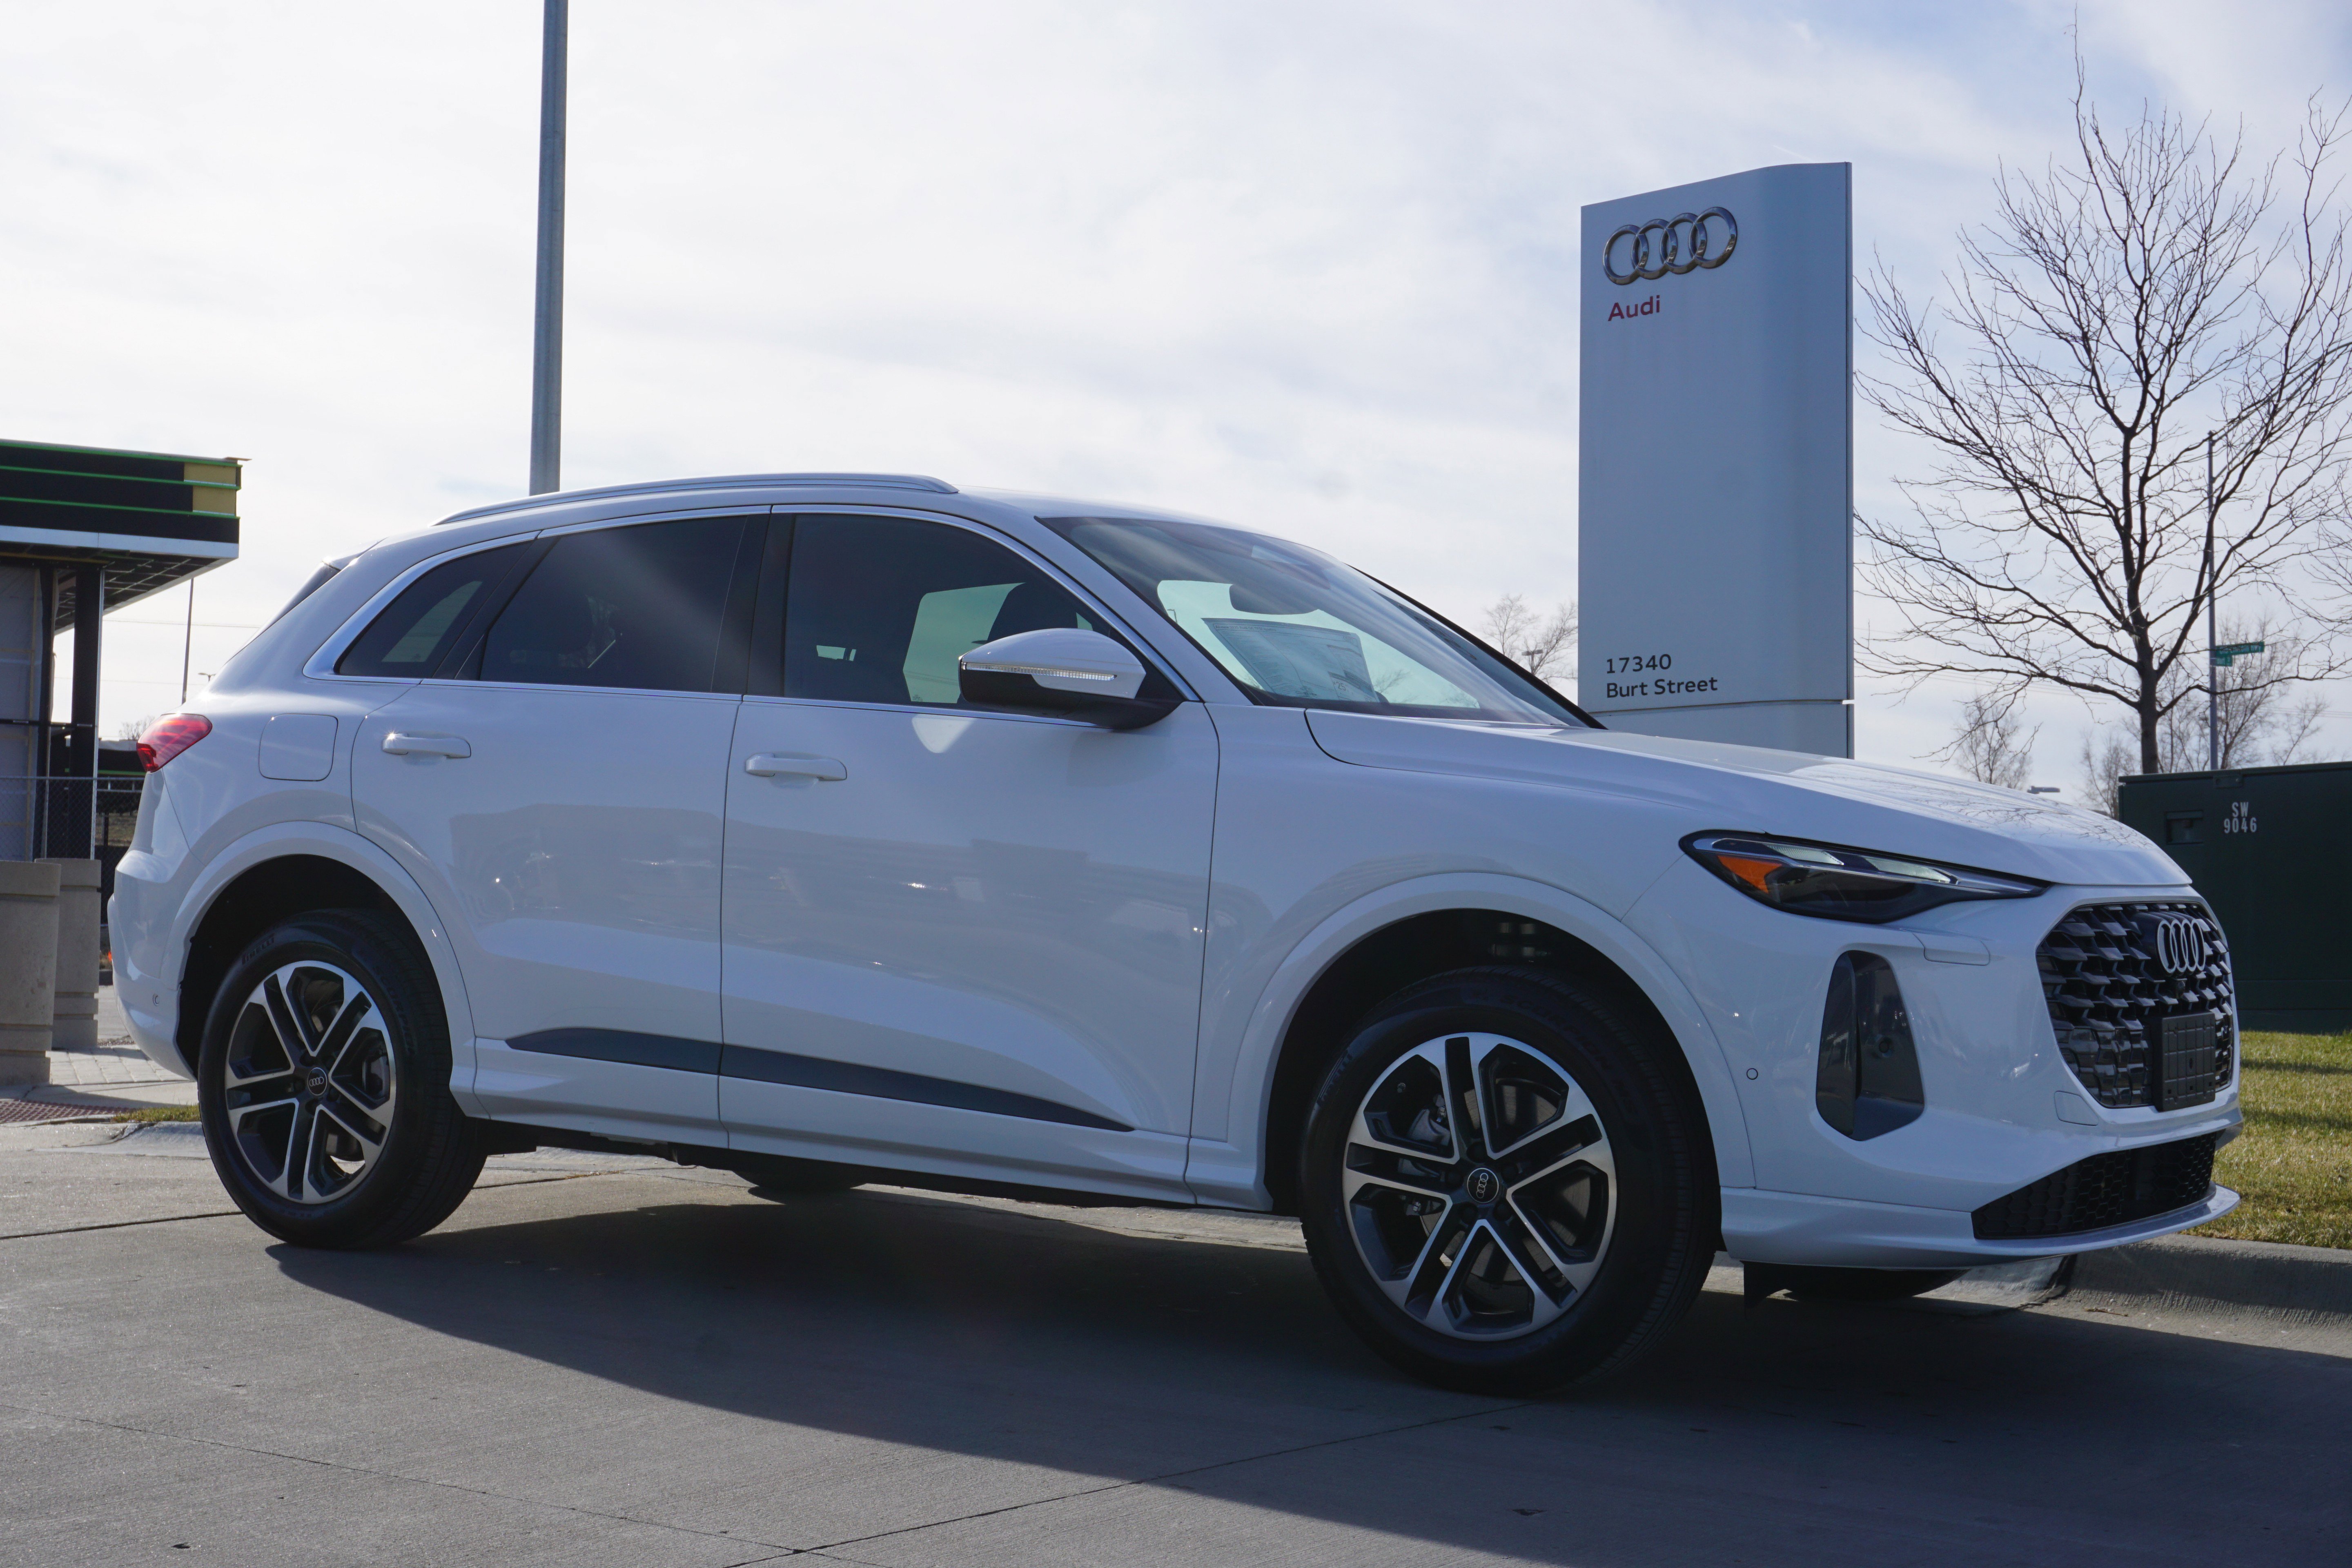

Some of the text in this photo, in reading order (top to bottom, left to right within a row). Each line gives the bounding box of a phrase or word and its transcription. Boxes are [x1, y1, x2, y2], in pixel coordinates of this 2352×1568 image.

[1608, 295, 1660, 321] Audi
[1607, 654, 1671, 674] 17340
[1607, 677, 1717, 698] Burt Street
[2232, 802, 2249, 817] SW
[2224, 817, 2257, 833] 9046
[243, 934, 275, 964] PIRELLI
